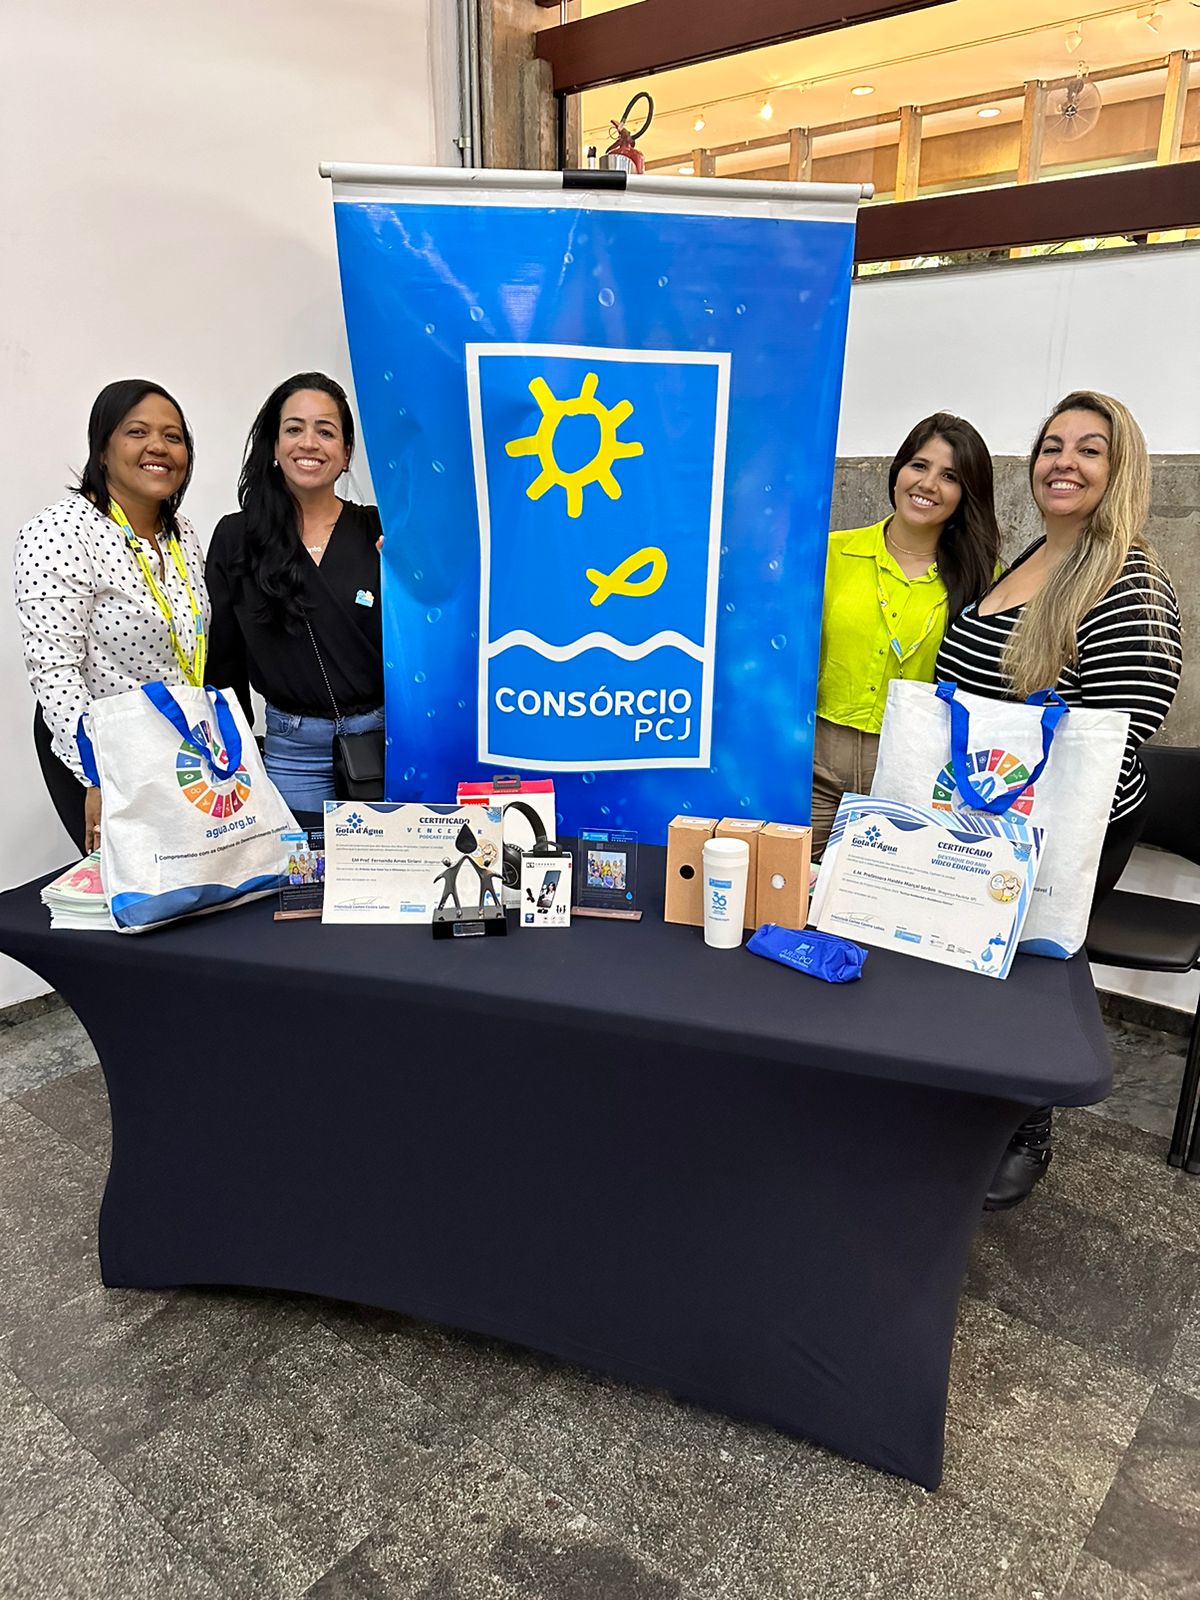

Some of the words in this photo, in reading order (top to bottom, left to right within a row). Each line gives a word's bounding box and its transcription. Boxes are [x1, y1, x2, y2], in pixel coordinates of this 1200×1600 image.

[495, 685, 692, 717] CONSÓRCIO
[634, 717, 691, 742] PCJ
[206, 815, 256, 838] agua.org.br
[419, 816, 470, 825] CERTIFICADO
[335, 826, 355, 834] Gota
[355, 825, 384, 836] d'Água
[407, 827, 483, 835] VENCER
[852, 837, 870, 847] Gota
[870, 840, 898, 853] d'Água
[937, 841, 993, 859] CERTIFICADO
[159, 853, 198, 861] Comprometido
[937, 853, 966, 864] DESTAQUE
[952, 862, 991, 876] EDUCATIVO
